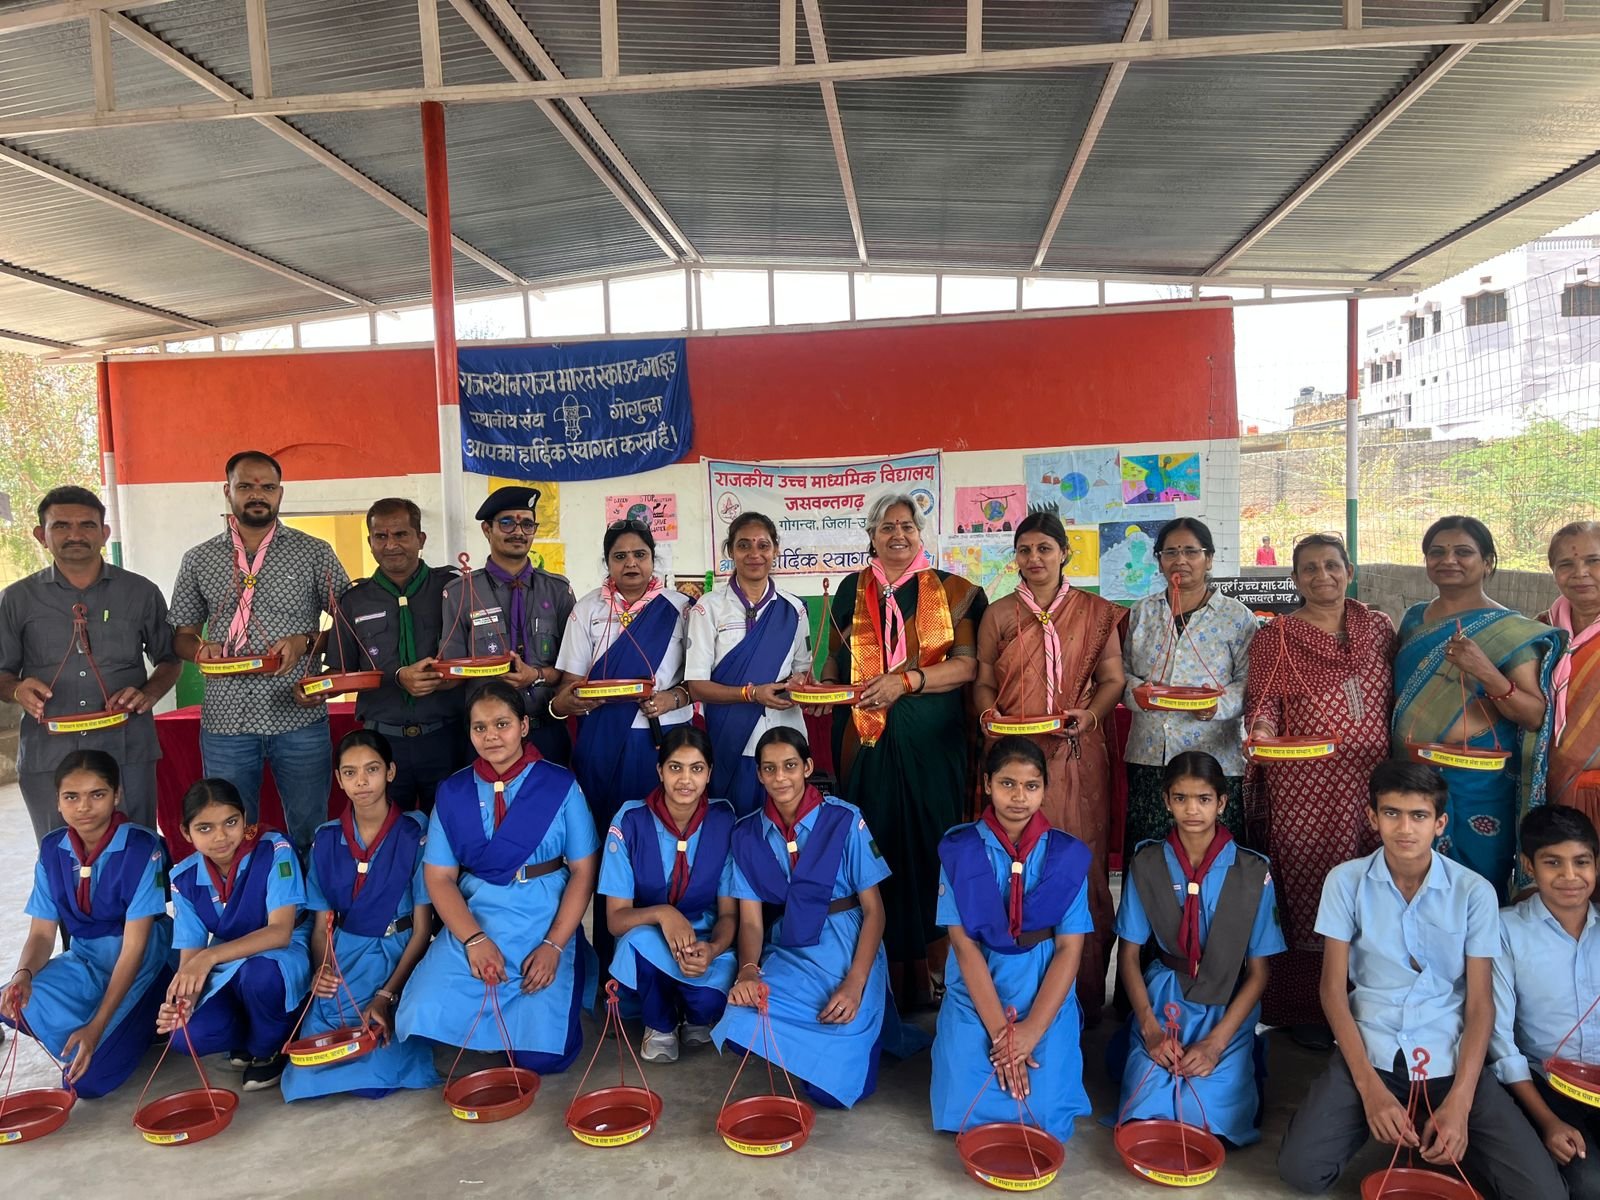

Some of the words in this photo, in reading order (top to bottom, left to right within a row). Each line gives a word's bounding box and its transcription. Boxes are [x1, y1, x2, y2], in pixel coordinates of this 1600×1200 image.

[459, 371, 521, 399] राजस्थान
[522, 370, 556, 399] राज्य
[556, 367, 596, 393] भारत
[596, 359, 639, 390] स्काउट
[644, 351, 677, 381] गाइड
[469, 409, 517, 429] स्थानीय
[519, 408, 546, 431] संघ
[609, 395, 663, 424] गोगुन्दा
[463, 438, 516, 462] आपका
[516, 437, 567, 471] हार्दिक
[566, 437, 618, 464] स्वागत
[619, 430, 657, 455] करता
[714, 468, 773, 488] राजकीय
[778, 474, 807, 489] उच्च
[810, 468, 876, 489] माध्यमिक
[880, 463, 936, 484] विद्यालय
[784, 493, 866, 513] जसवन्तगढ़
[1238, 581, 1259, 591] उच्च
[1261, 577, 1297, 591] माध्यमि
